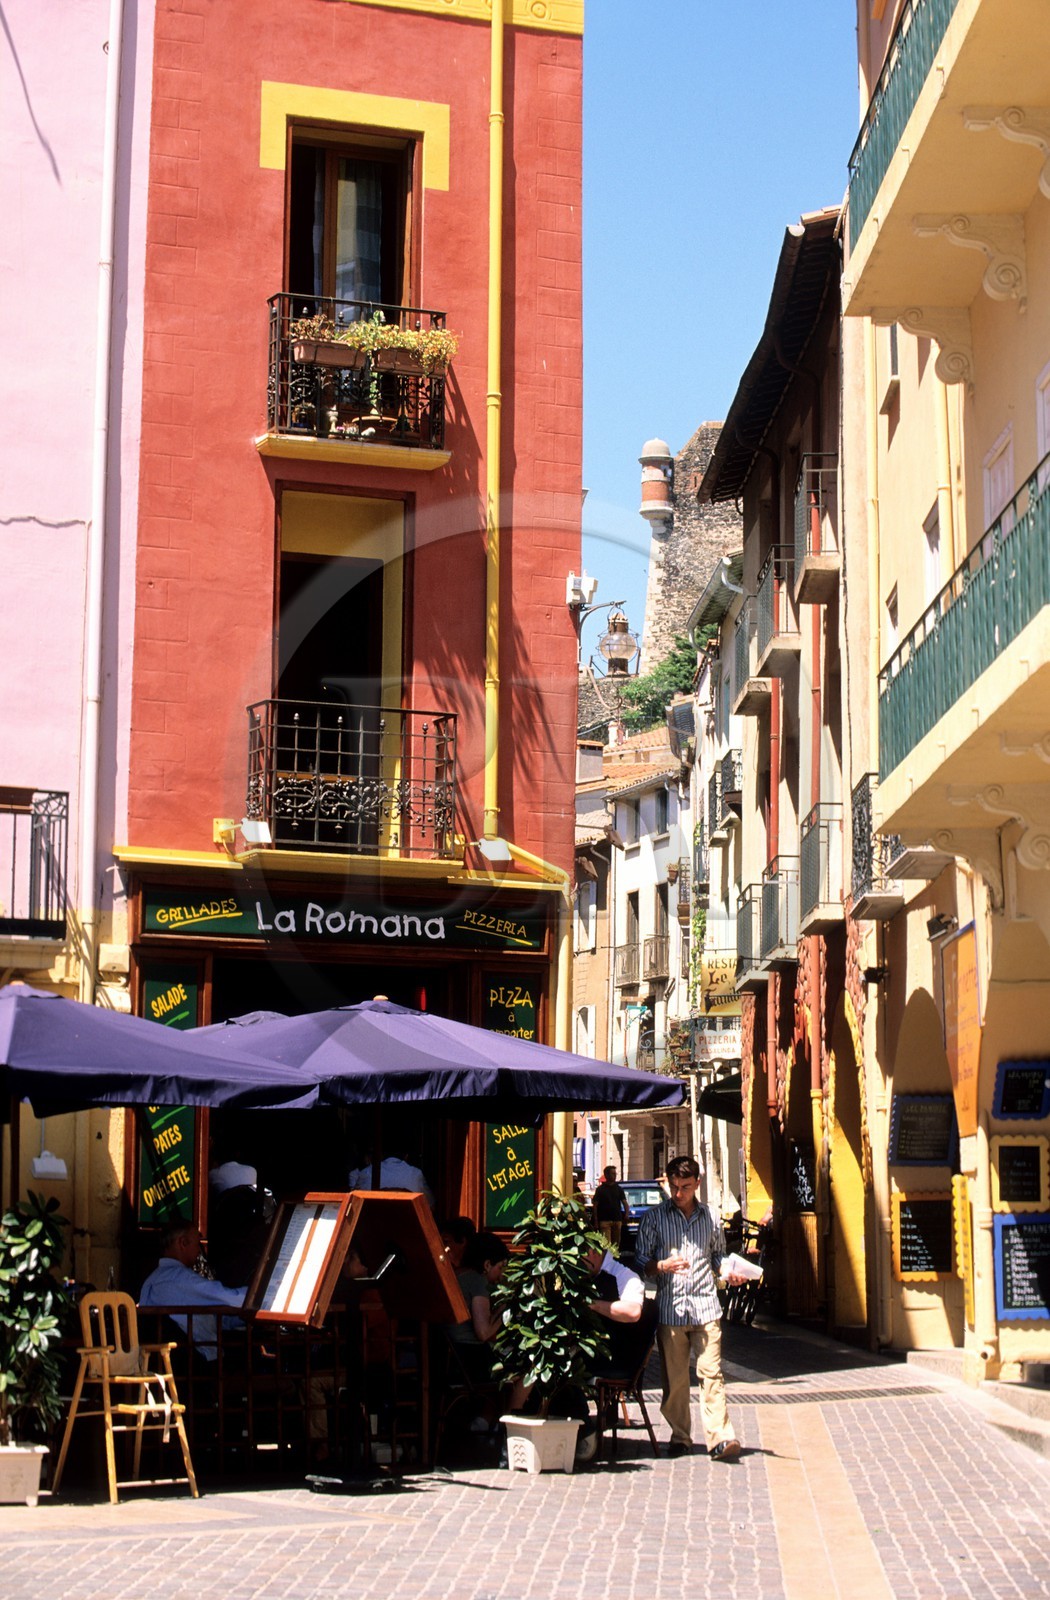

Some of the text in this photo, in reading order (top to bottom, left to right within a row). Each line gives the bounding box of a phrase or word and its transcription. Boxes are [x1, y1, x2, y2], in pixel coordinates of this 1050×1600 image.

[155, 898, 238, 924] GRILLADES
[255, 901, 446, 940] La Romana
[463, 909, 528, 938] PIZZERIA
[706, 970, 728, 987] Le
[151, 983, 188, 1018] SALADE
[489, 986, 534, 1008] PIZZA
[698, 1034, 738, 1046] PIZZERIA
[152, 1124, 183, 1155] PATES
[506, 1146, 517, 1162] à
[142, 1165, 191, 1208] OMELETTE
[486, 1160, 533, 1192] L'ETAGE
